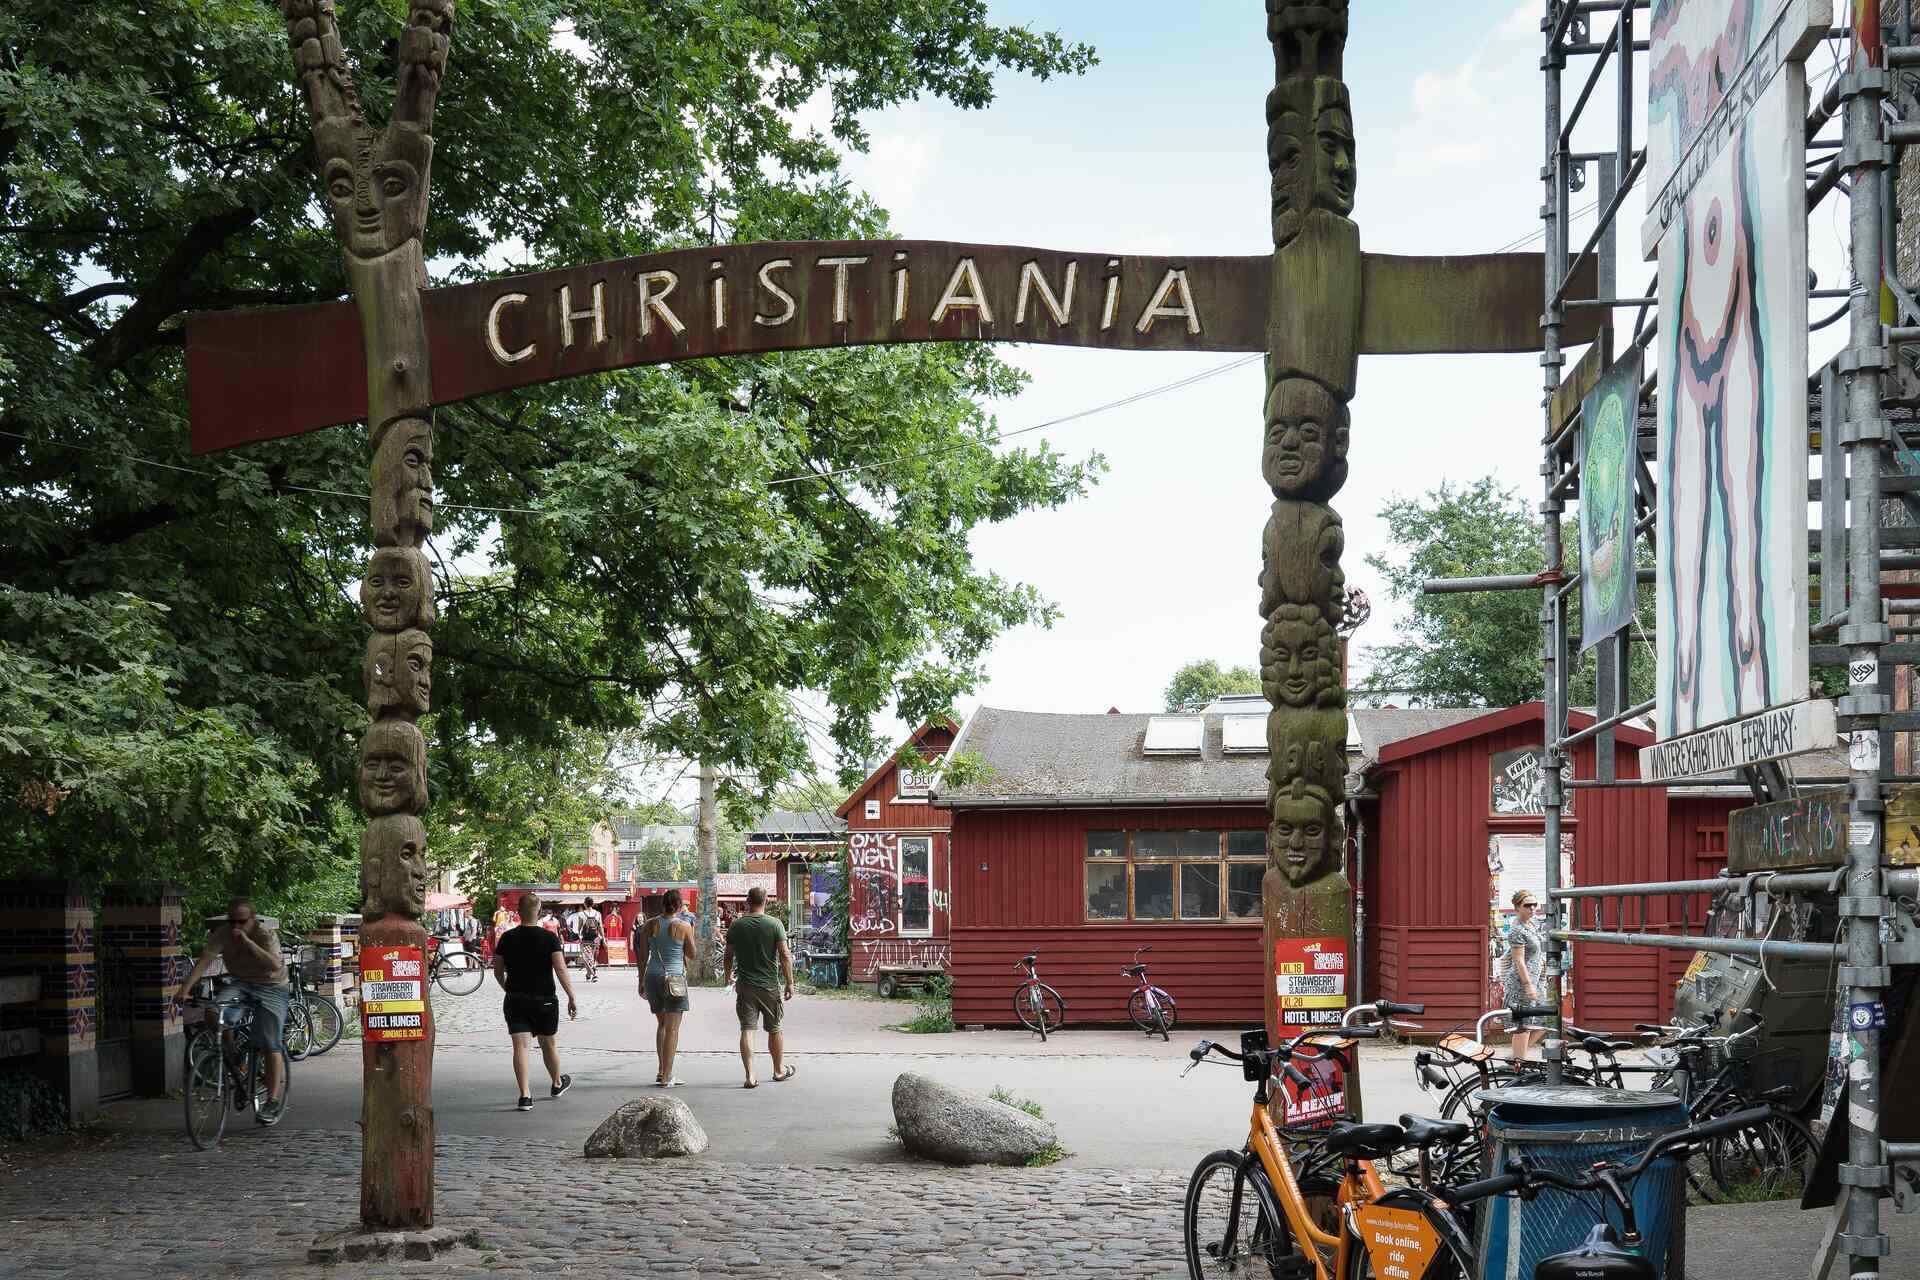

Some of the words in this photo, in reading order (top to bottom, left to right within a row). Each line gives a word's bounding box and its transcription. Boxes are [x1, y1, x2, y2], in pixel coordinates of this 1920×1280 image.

[1650, 726, 1735, 779] WINTEREXHIBITION
[370, 982, 414, 993] STRAWBERRY
[1288, 975, 1337, 987] STRAWBERRY
[368, 1015, 389, 1028] HOTEL
[390, 1014, 421, 1027] HUNGER
[1284, 1010, 1309, 1024] HOTEL
[1310, 1010, 1342, 1024] HUNGER
[1375, 1231, 1394, 1246] Book
[1395, 1236, 1422, 1252] online,
[1389, 1249, 1405, 1263] ride
[1383, 1264, 1409, 1279] offline
